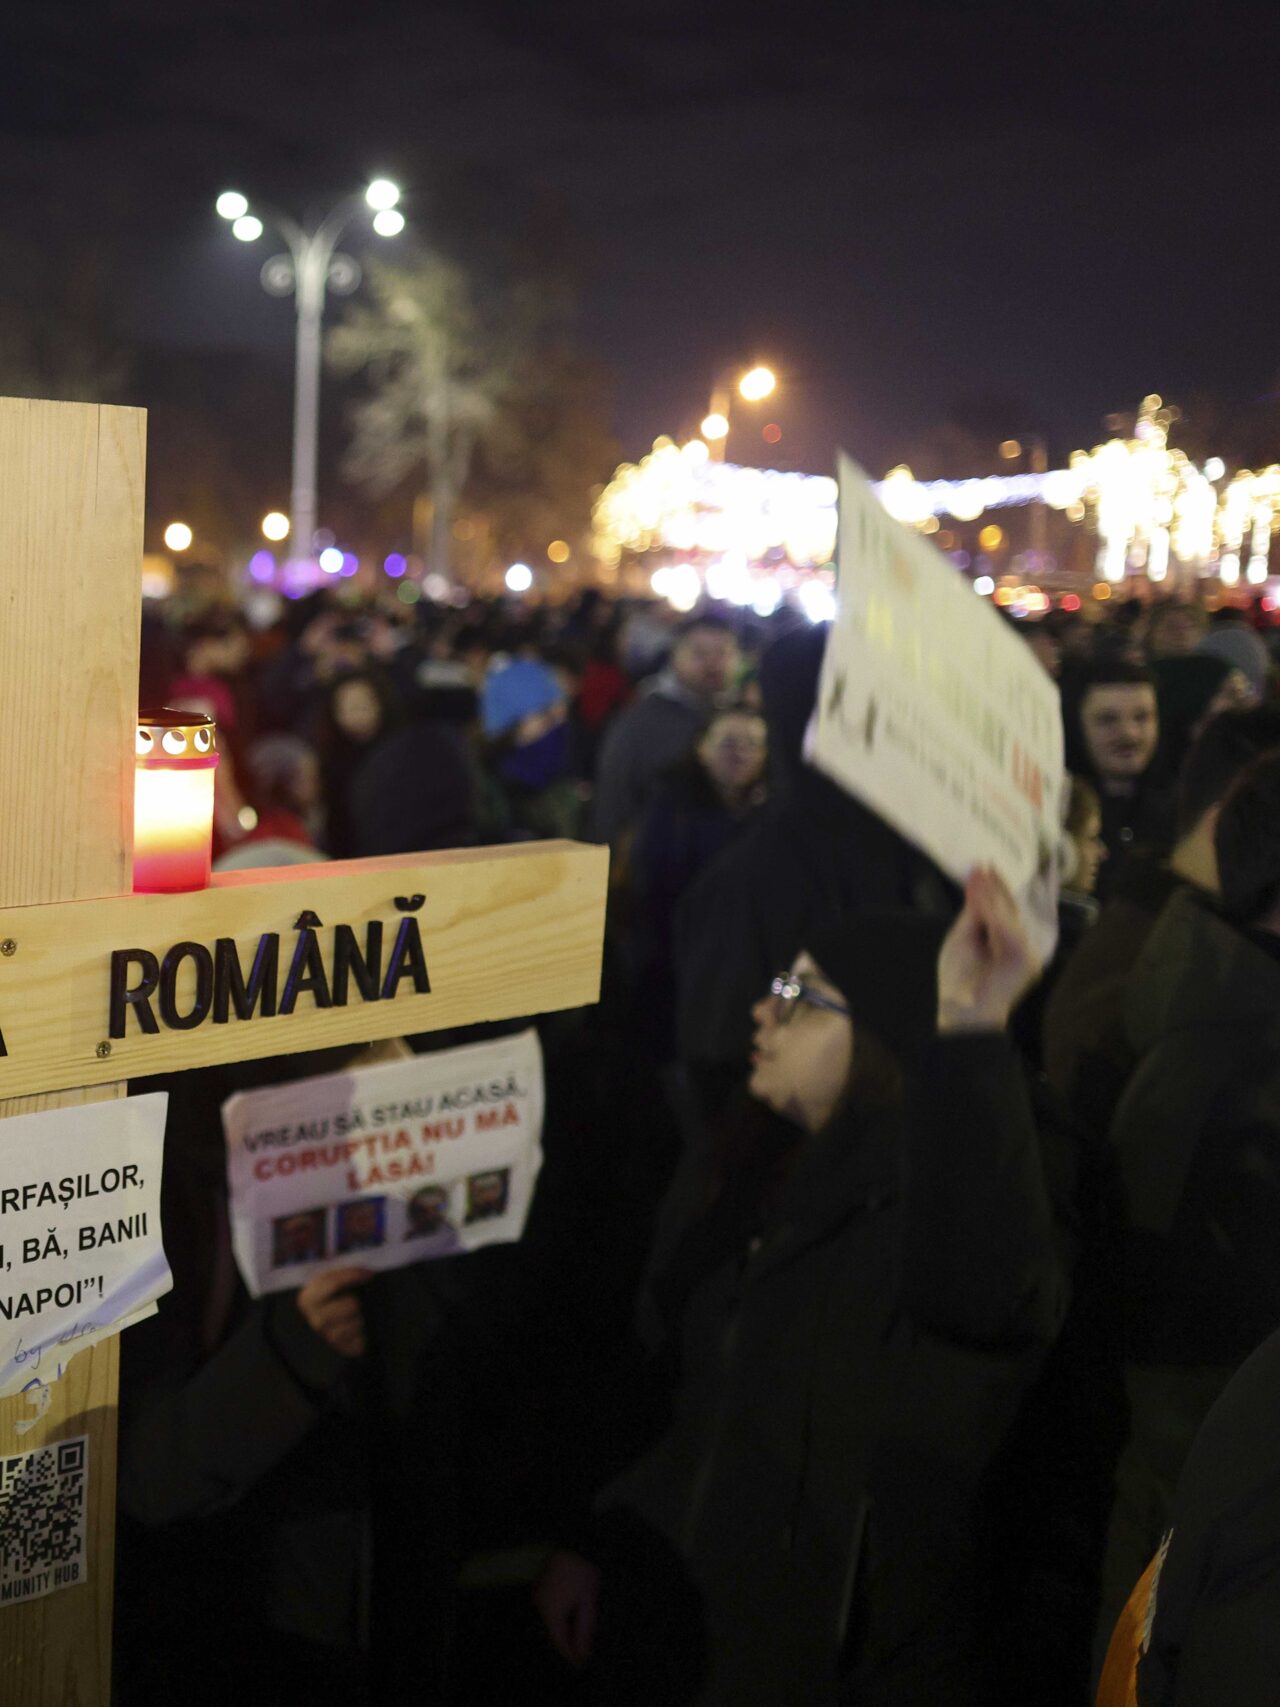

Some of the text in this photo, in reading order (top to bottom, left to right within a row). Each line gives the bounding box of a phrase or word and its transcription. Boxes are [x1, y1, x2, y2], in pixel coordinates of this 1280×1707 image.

[108, 893, 431, 1039] ROMÂNĂ
[244, 1120, 329, 1152] VREAU
[372, 1098, 433, 1128] STAU
[422, 1116, 465, 1144] NU
[22, 1227, 68, 1264] BĂ,
[78, 1212, 148, 1251] BANII
[54, 1563, 80, 1585] HUB
